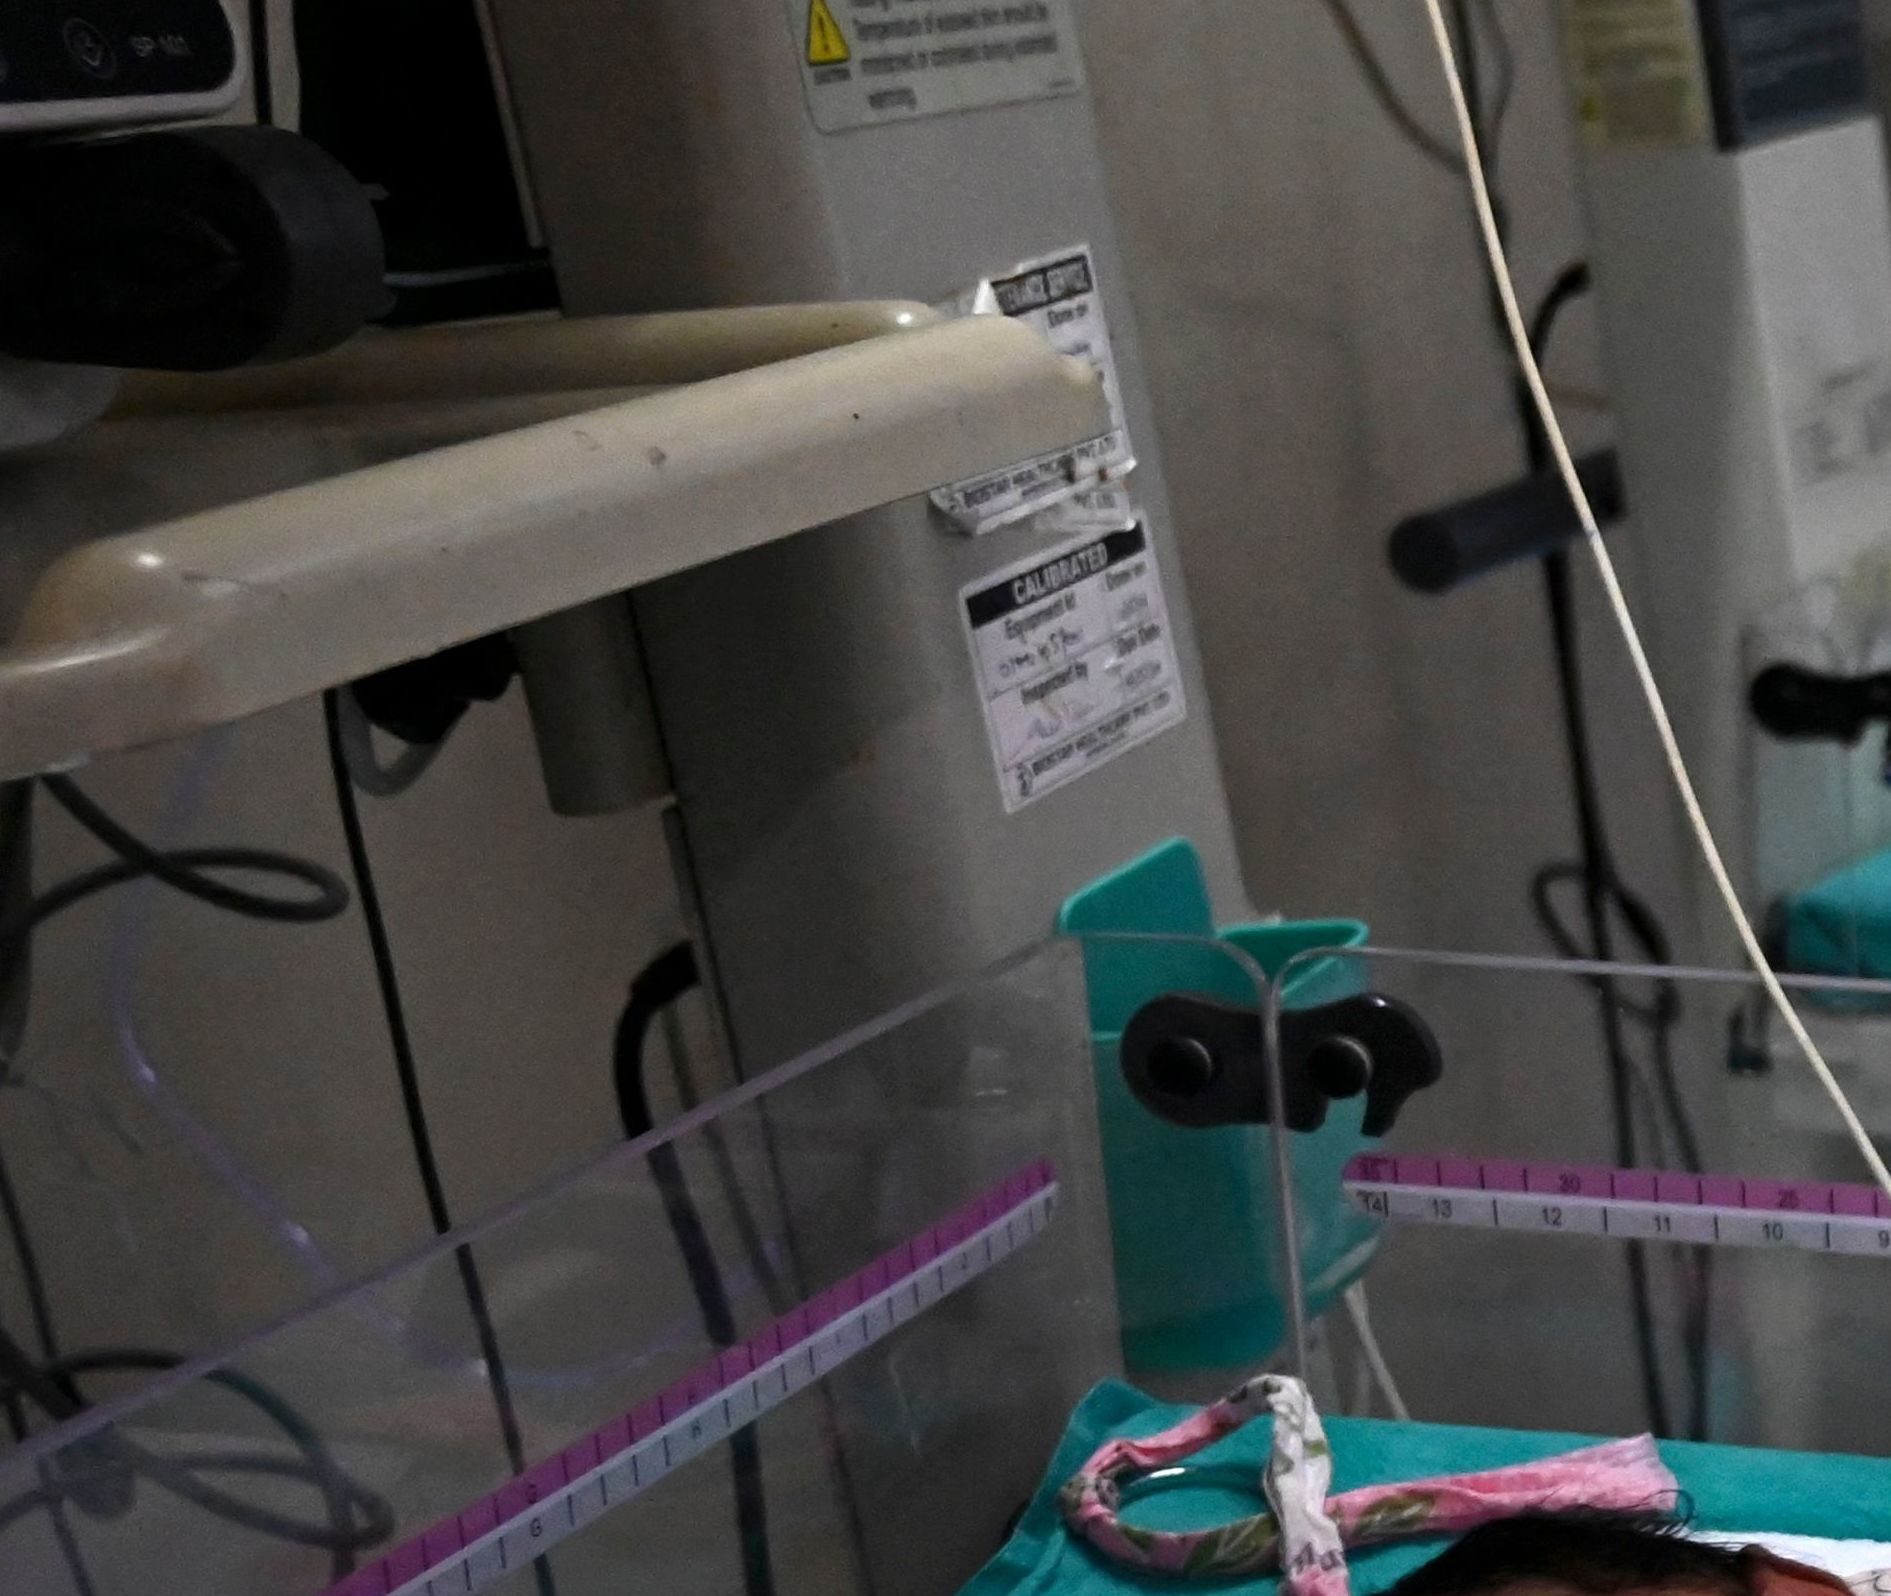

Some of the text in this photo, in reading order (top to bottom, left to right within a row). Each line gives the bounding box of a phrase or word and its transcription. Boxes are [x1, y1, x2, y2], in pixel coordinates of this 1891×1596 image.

[1012, 541, 1109, 605] CALIBRATED
[1559, 1173, 1581, 1194] 30
[1433, 1198, 1453, 1219] 13
[1541, 1206, 1563, 1227] 12
[1654, 1214, 1672, 1233] 11
[1761, 1221, 1785, 1241] 10
[1878, 1229, 1891, 1249] 9
